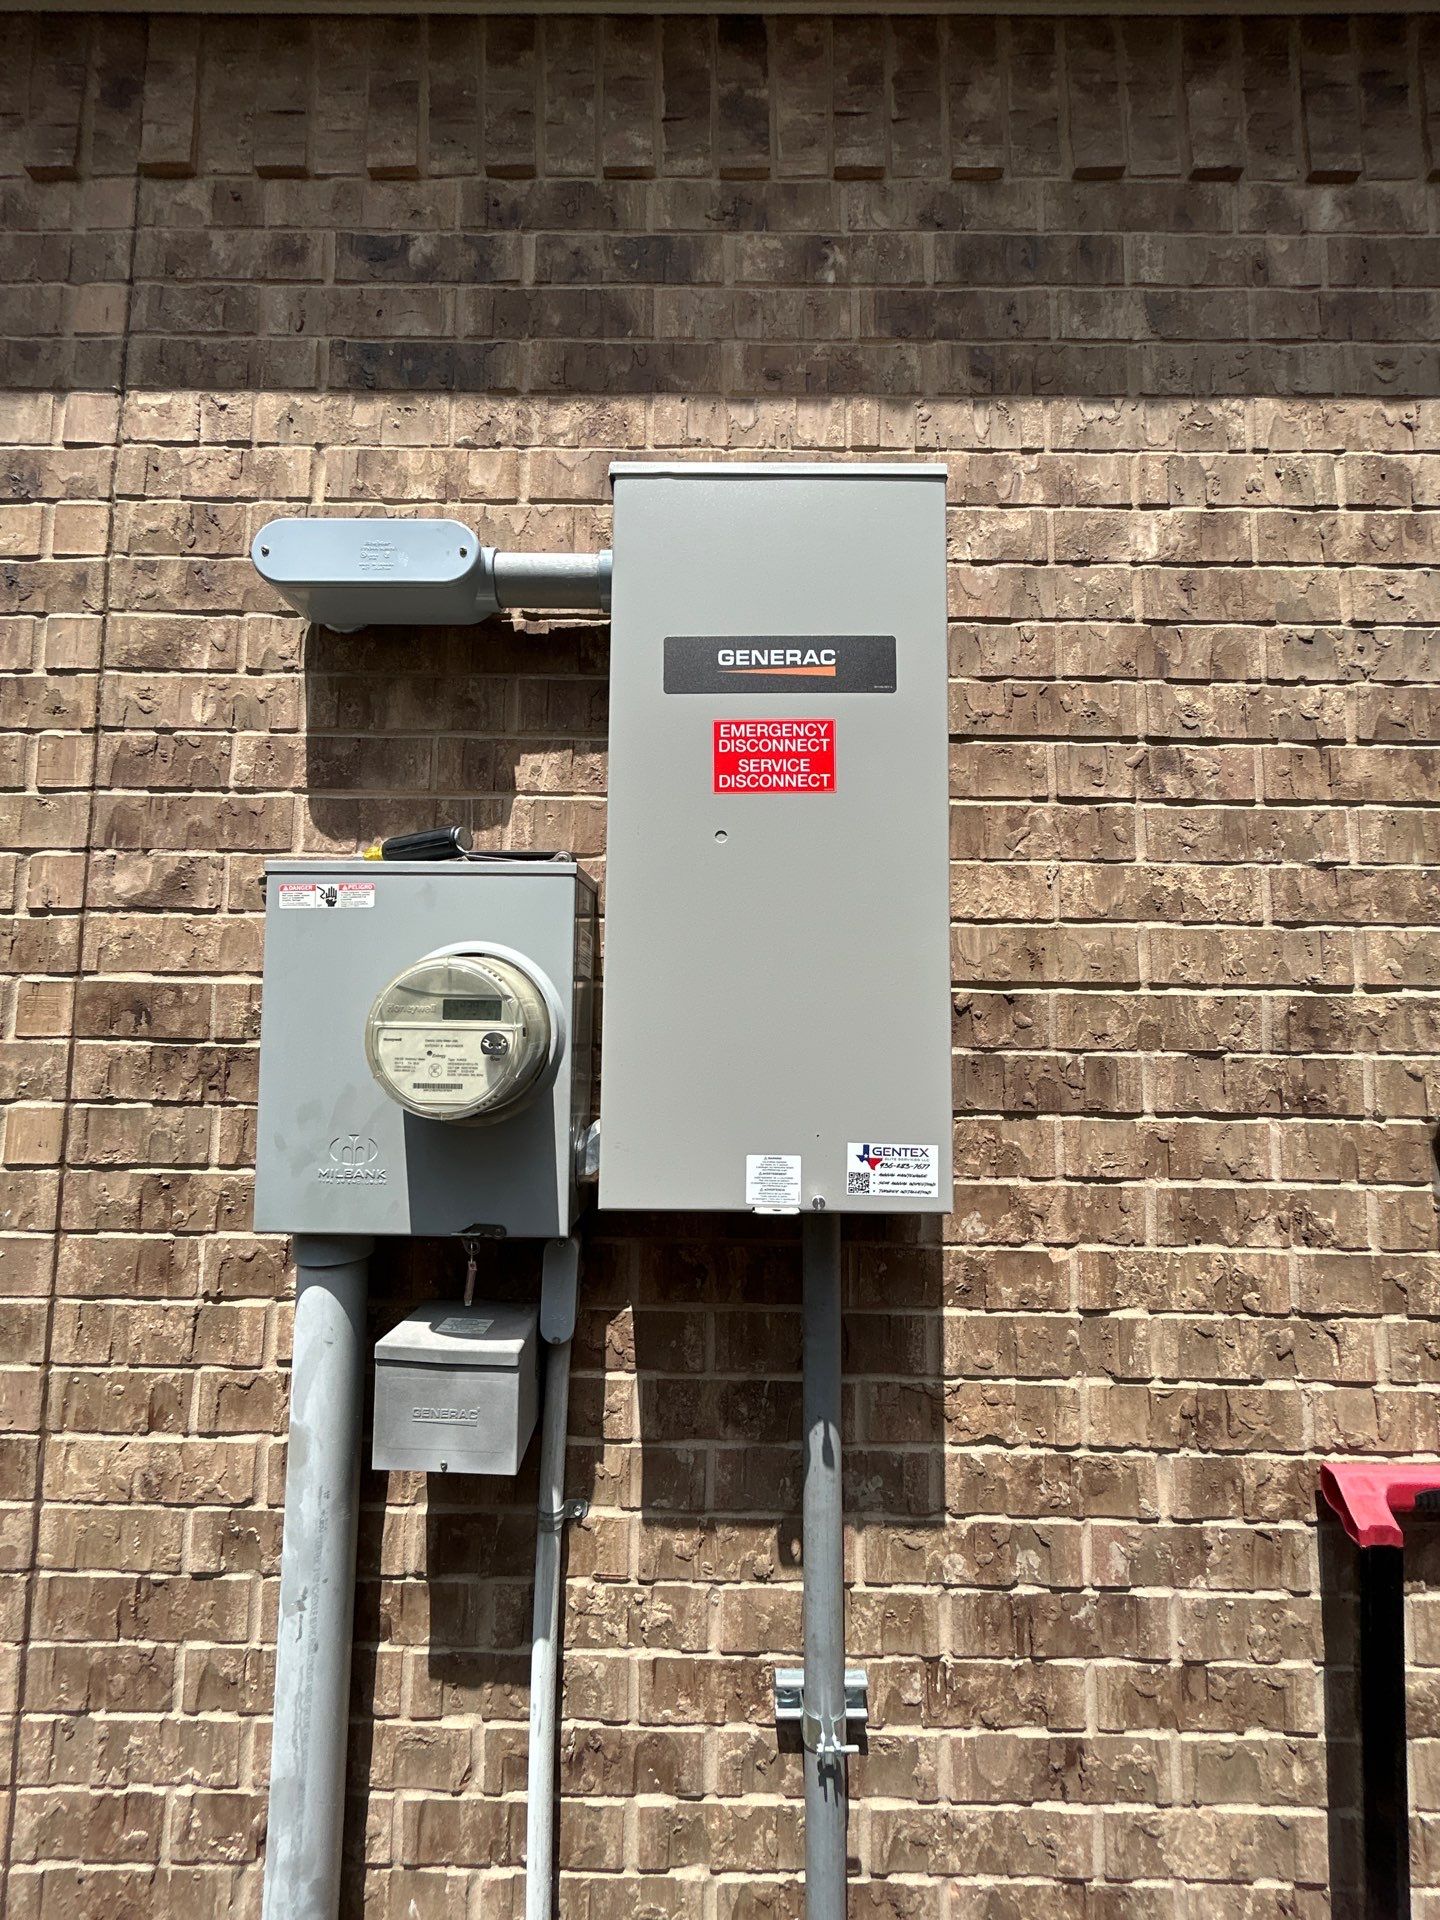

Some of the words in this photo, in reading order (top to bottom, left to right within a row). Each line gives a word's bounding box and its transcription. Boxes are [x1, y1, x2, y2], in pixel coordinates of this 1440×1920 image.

[717, 649, 836, 666] GENERAC
[720, 723, 829, 737] EMERGENCY
[718, 738, 831, 753] DISCONNECT
[738, 758, 811, 772] SERVICE
[719, 773, 831, 788] DISCONNECT
[386, 1003, 437, 1015] Honeywell
[872, 1146, 930, 1158] GENTEX
[318, 1168, 387, 1179] MILBANK
[412, 1407, 478, 1419] GENERAC
